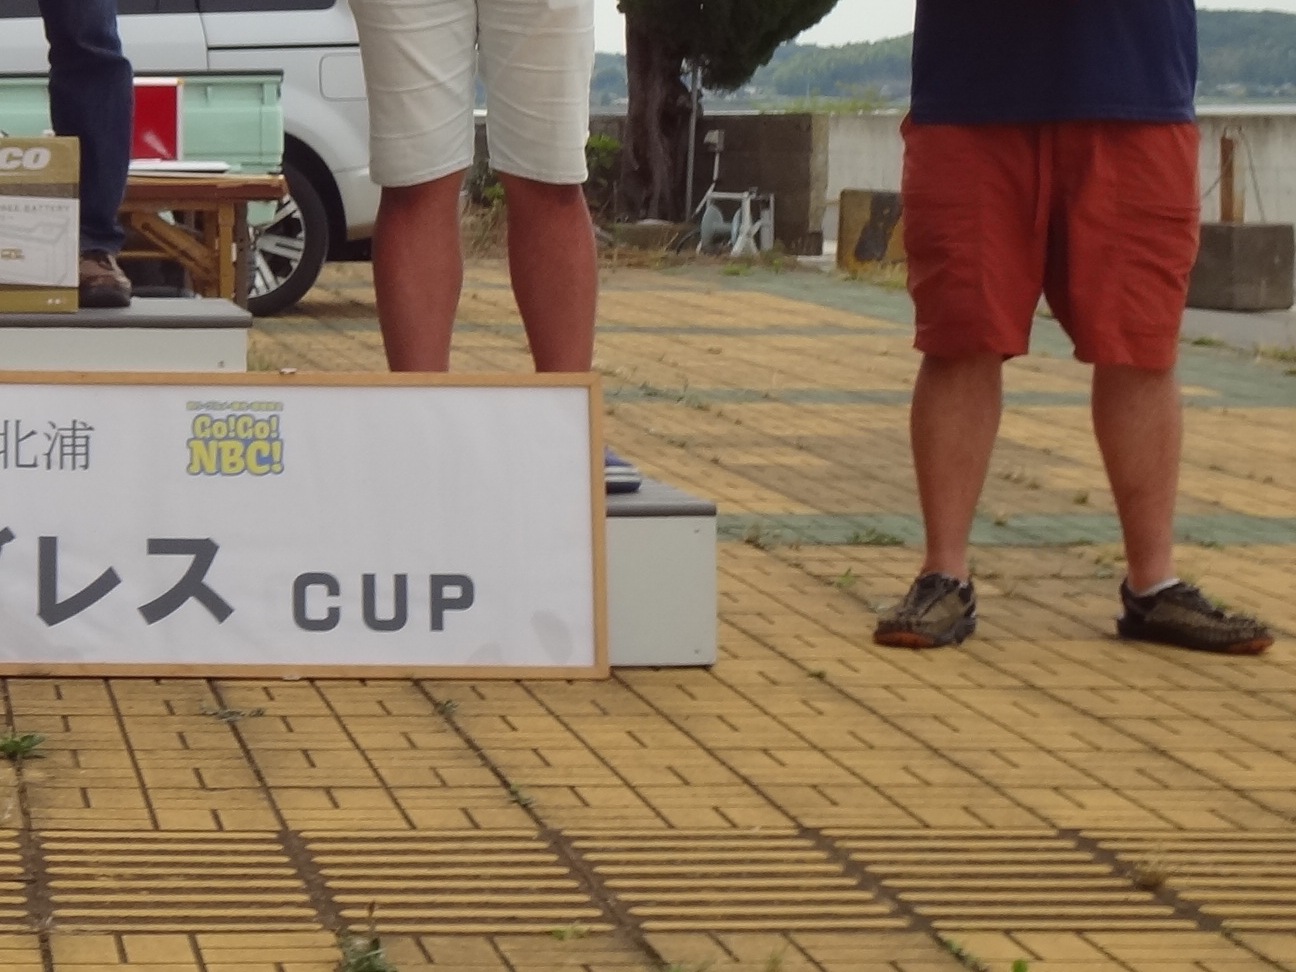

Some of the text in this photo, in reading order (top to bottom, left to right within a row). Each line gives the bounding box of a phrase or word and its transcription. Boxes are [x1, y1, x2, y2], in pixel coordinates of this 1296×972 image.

[193, 413, 280, 439] Go!Go!
[186, 437, 284, 475] NBC!
[291, 571, 475, 632] CUP
